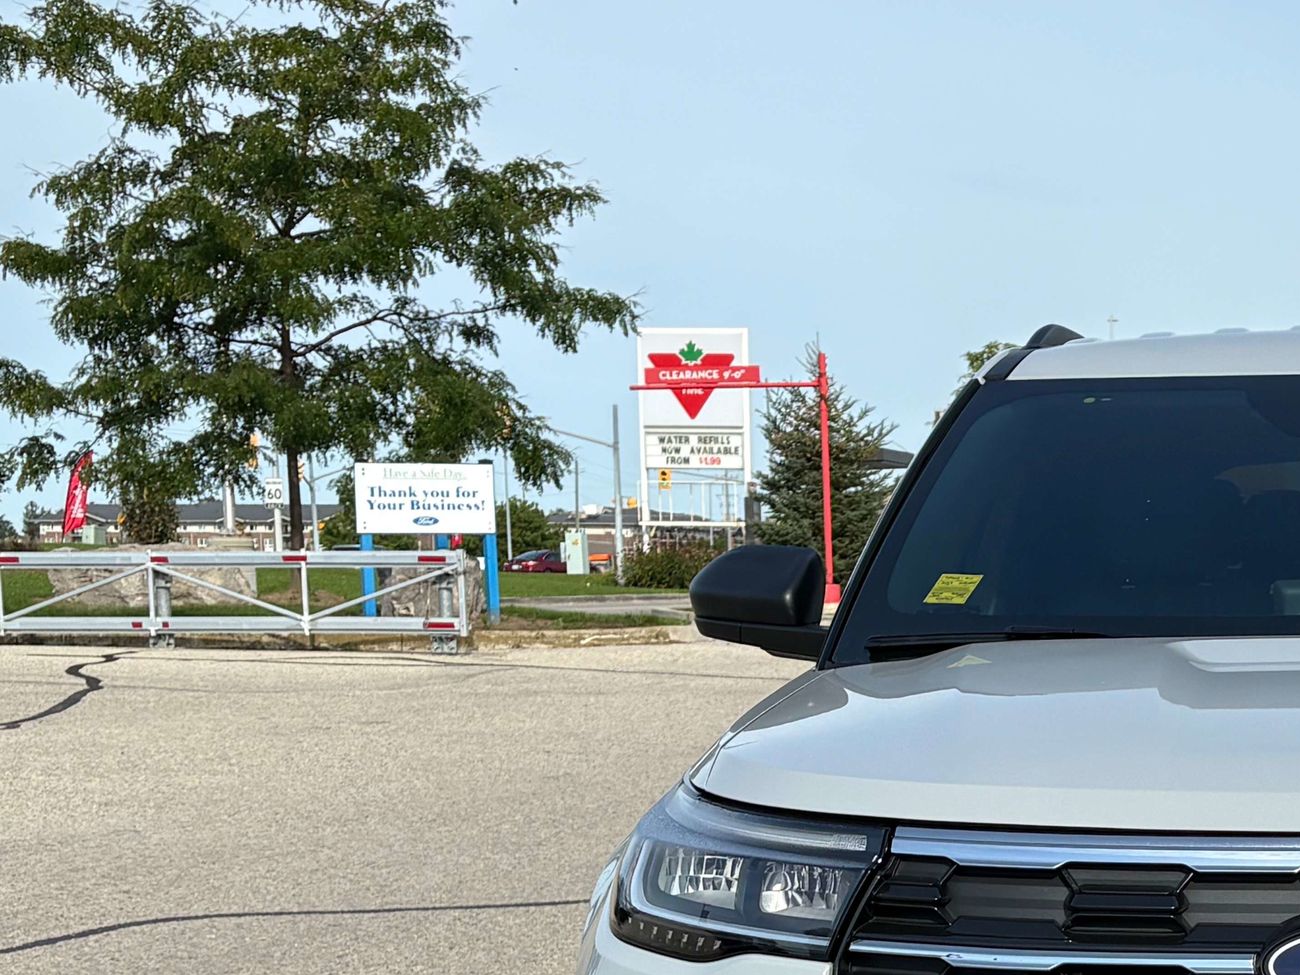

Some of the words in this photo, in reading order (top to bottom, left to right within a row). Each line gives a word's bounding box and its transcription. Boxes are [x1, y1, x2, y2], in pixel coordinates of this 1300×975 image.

[658, 369, 720, 380] CLEARANCE
[658, 436, 690, 445] WATER
[697, 436, 731, 445] REFILLS
[661, 446, 682, 455] NOW
[690, 446, 740, 455] AVAILABLE
[666, 456, 690, 465] FROM
[267, 488, 282, 500] 60
[367, 485, 417, 498] Thank
[423, 488, 450, 501] you
[455, 486, 479, 498] for
[366, 499, 405, 511] Your
[410, 499, 486, 511] Business!
